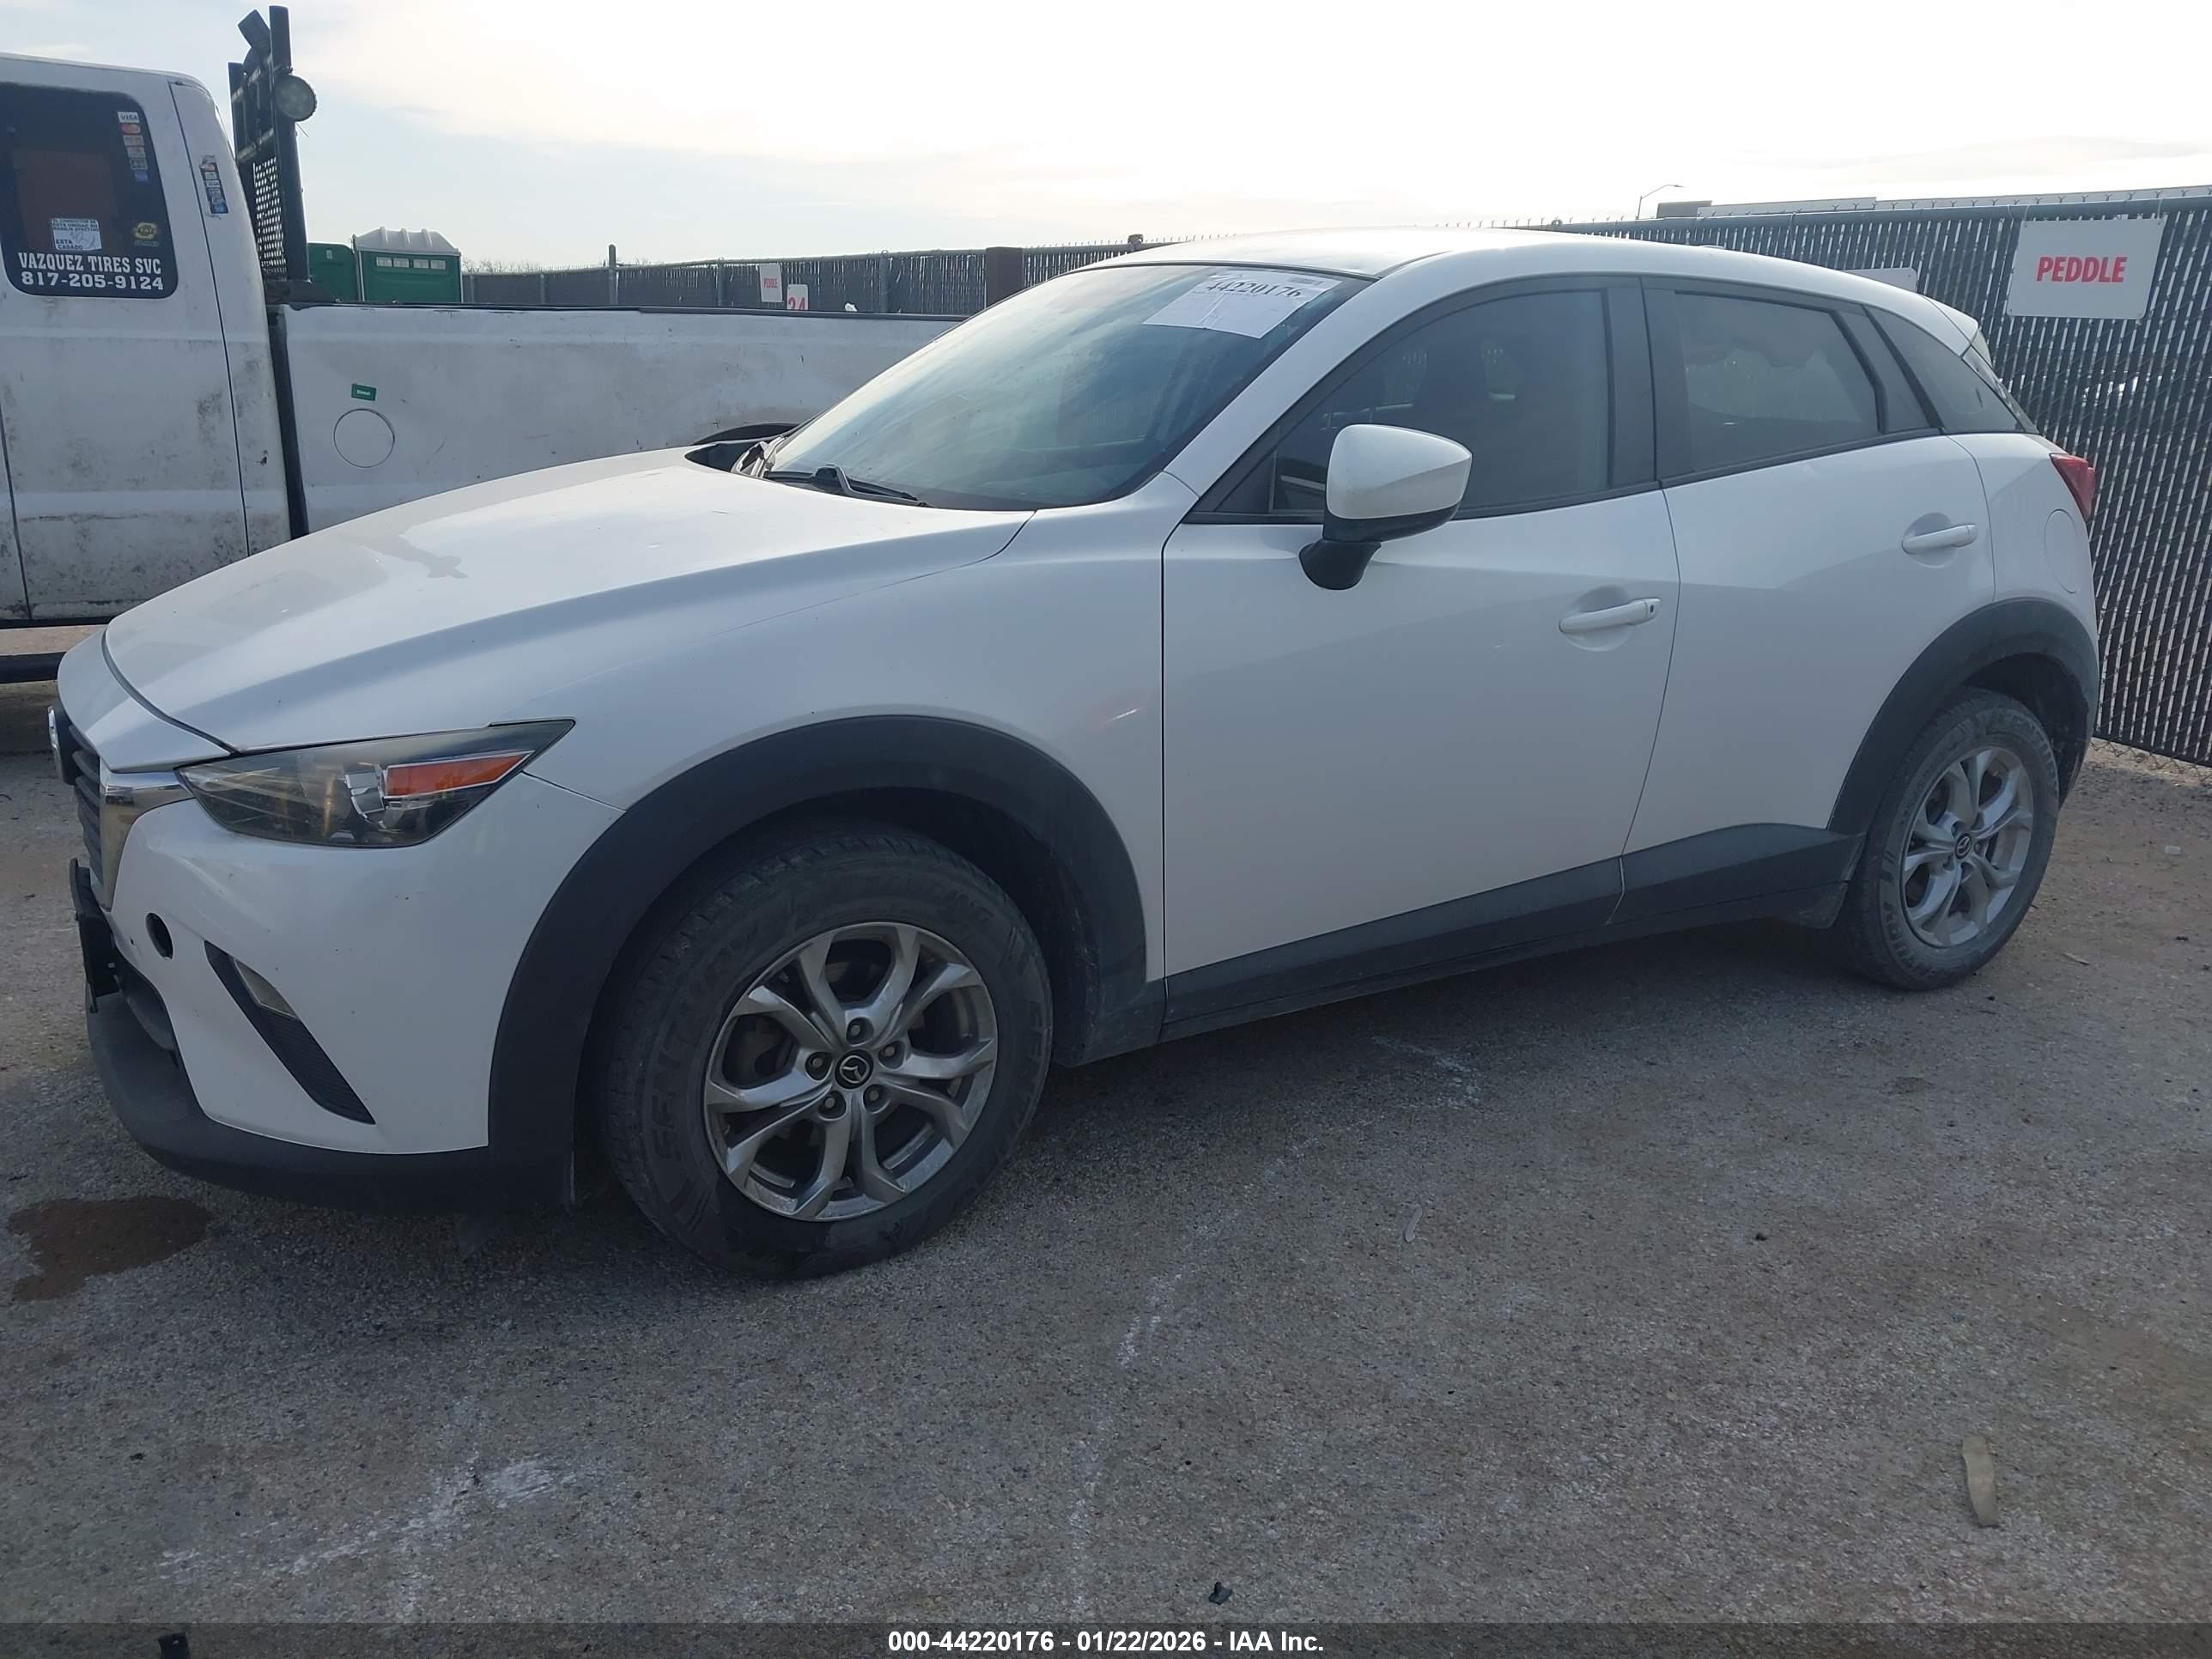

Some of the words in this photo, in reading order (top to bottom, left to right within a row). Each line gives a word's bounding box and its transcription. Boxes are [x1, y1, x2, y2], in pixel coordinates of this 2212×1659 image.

[18, 252, 84, 271] VAZQUEZ
[88, 256, 131, 273] TIRES
[135, 258, 161, 274] SVC
[2036, 256, 2128, 283] PEDDLE
[21, 271, 164, 290] 817-205-9124
[1206, 281, 1304, 298] 44220176
